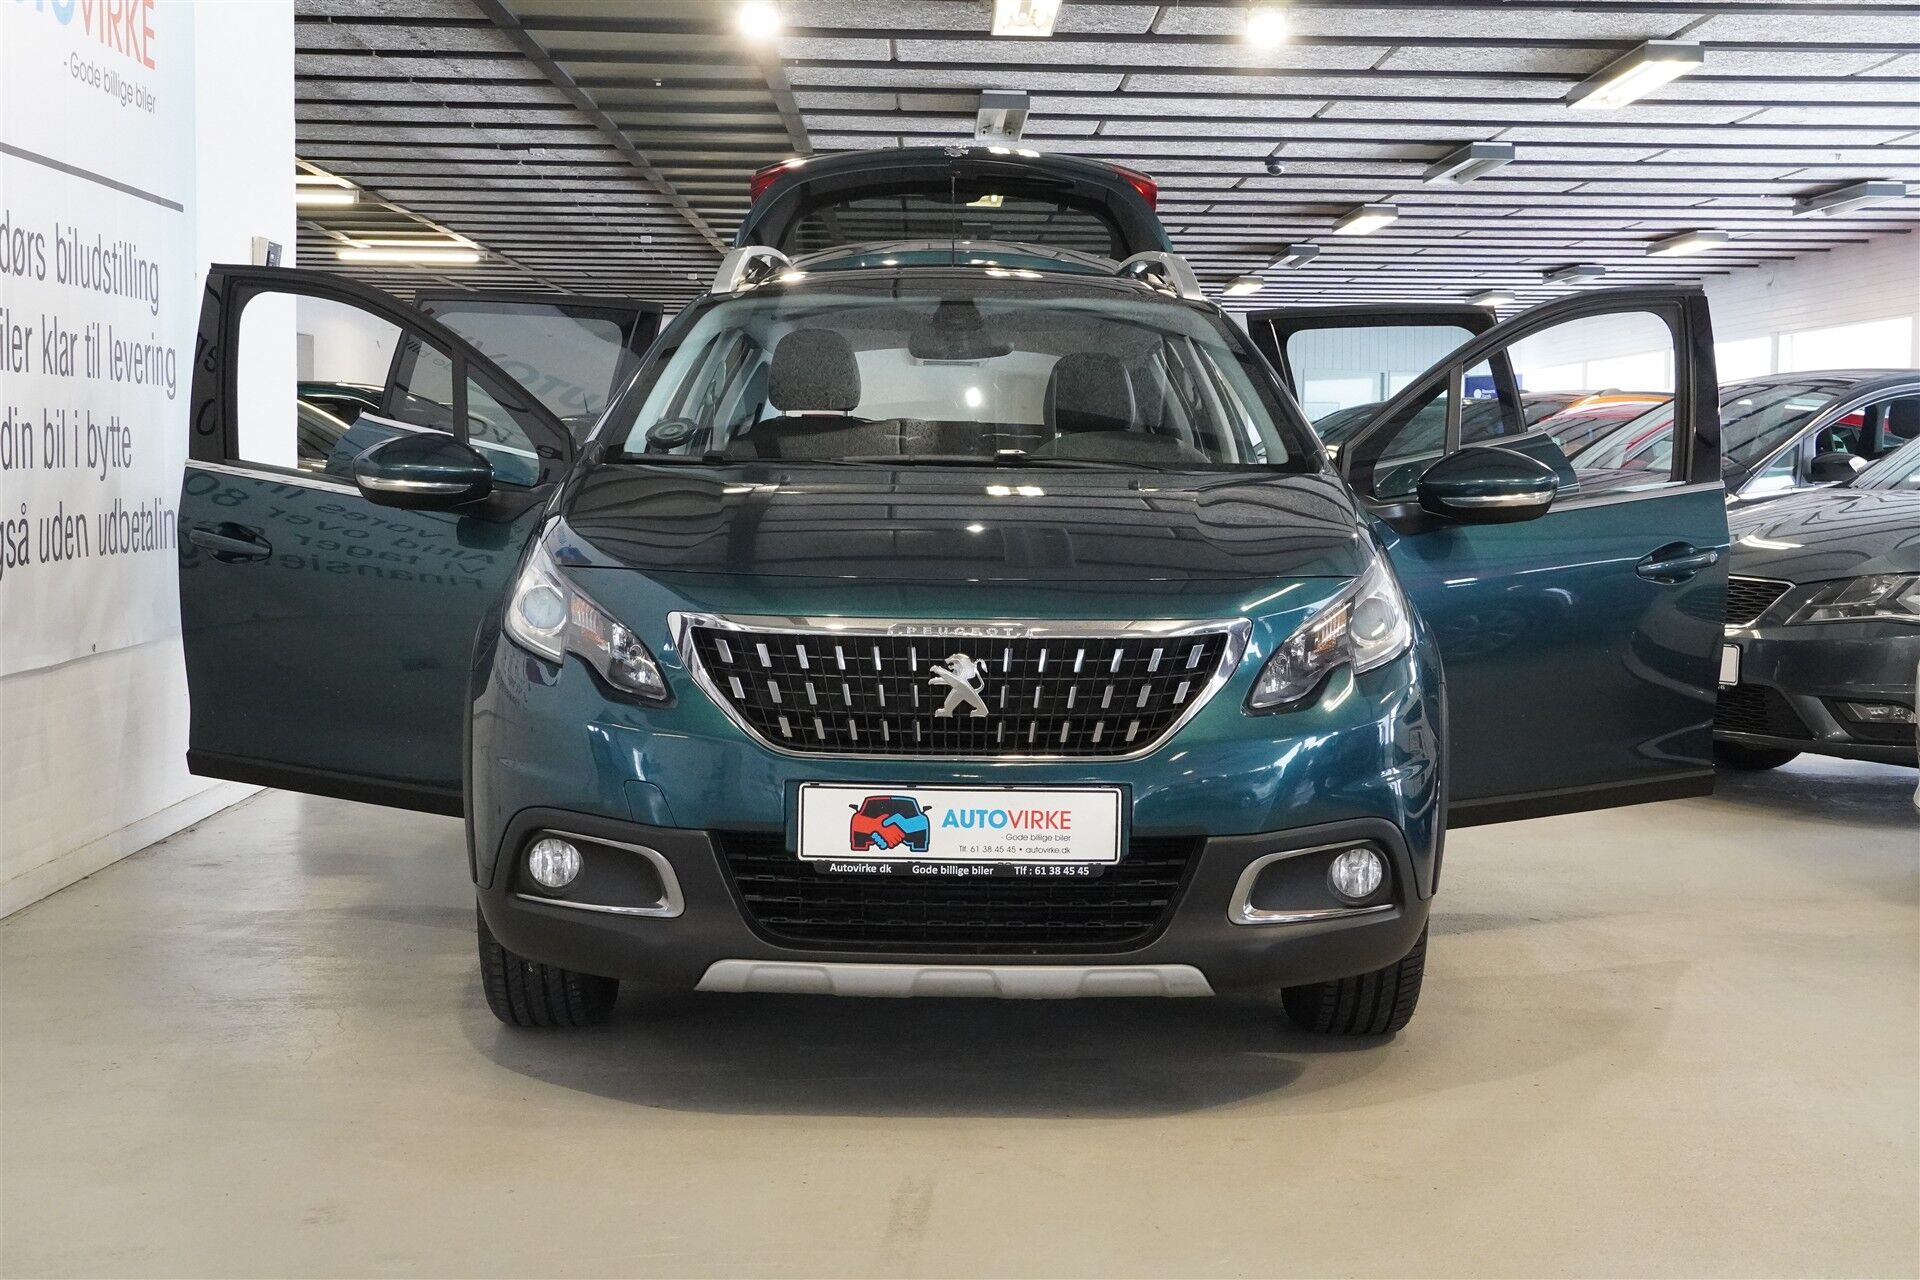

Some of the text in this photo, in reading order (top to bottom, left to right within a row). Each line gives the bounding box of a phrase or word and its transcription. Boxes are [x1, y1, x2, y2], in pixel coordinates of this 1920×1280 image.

[70, 51, 101, 88] Gode
[103, 67, 133, 107] billige
[135, 82, 156, 114] biler
[0, 210, 159, 316] dørs biludstilling
[42, 313, 78, 377] klar
[85, 322, 100, 379] til
[109, 325, 176, 400] levering
[1, 406, 132, 481] din bil i bytte
[39, 501, 90, 564] uden
[98, 498, 177, 556] udbetalin
[941, 808, 1072, 830] AUTOVIRKE
[1005, 833, 1029, 842] Gode
[1030, 833, 1053, 844] billige
[1054, 834, 1071, 842] biler
[829, 863, 877, 873] Autovirke
[879, 864, 892, 874] dk
[911, 864, 938, 875] Gode
[940, 864, 969, 877] billige
[971, 865, 994, 876] biler
[1034, 866, 1047, 876] 61
[1048, 866, 1061, 876] 38
[1062, 866, 1076, 876] 45
[1077, 866, 1090, 876] 45
